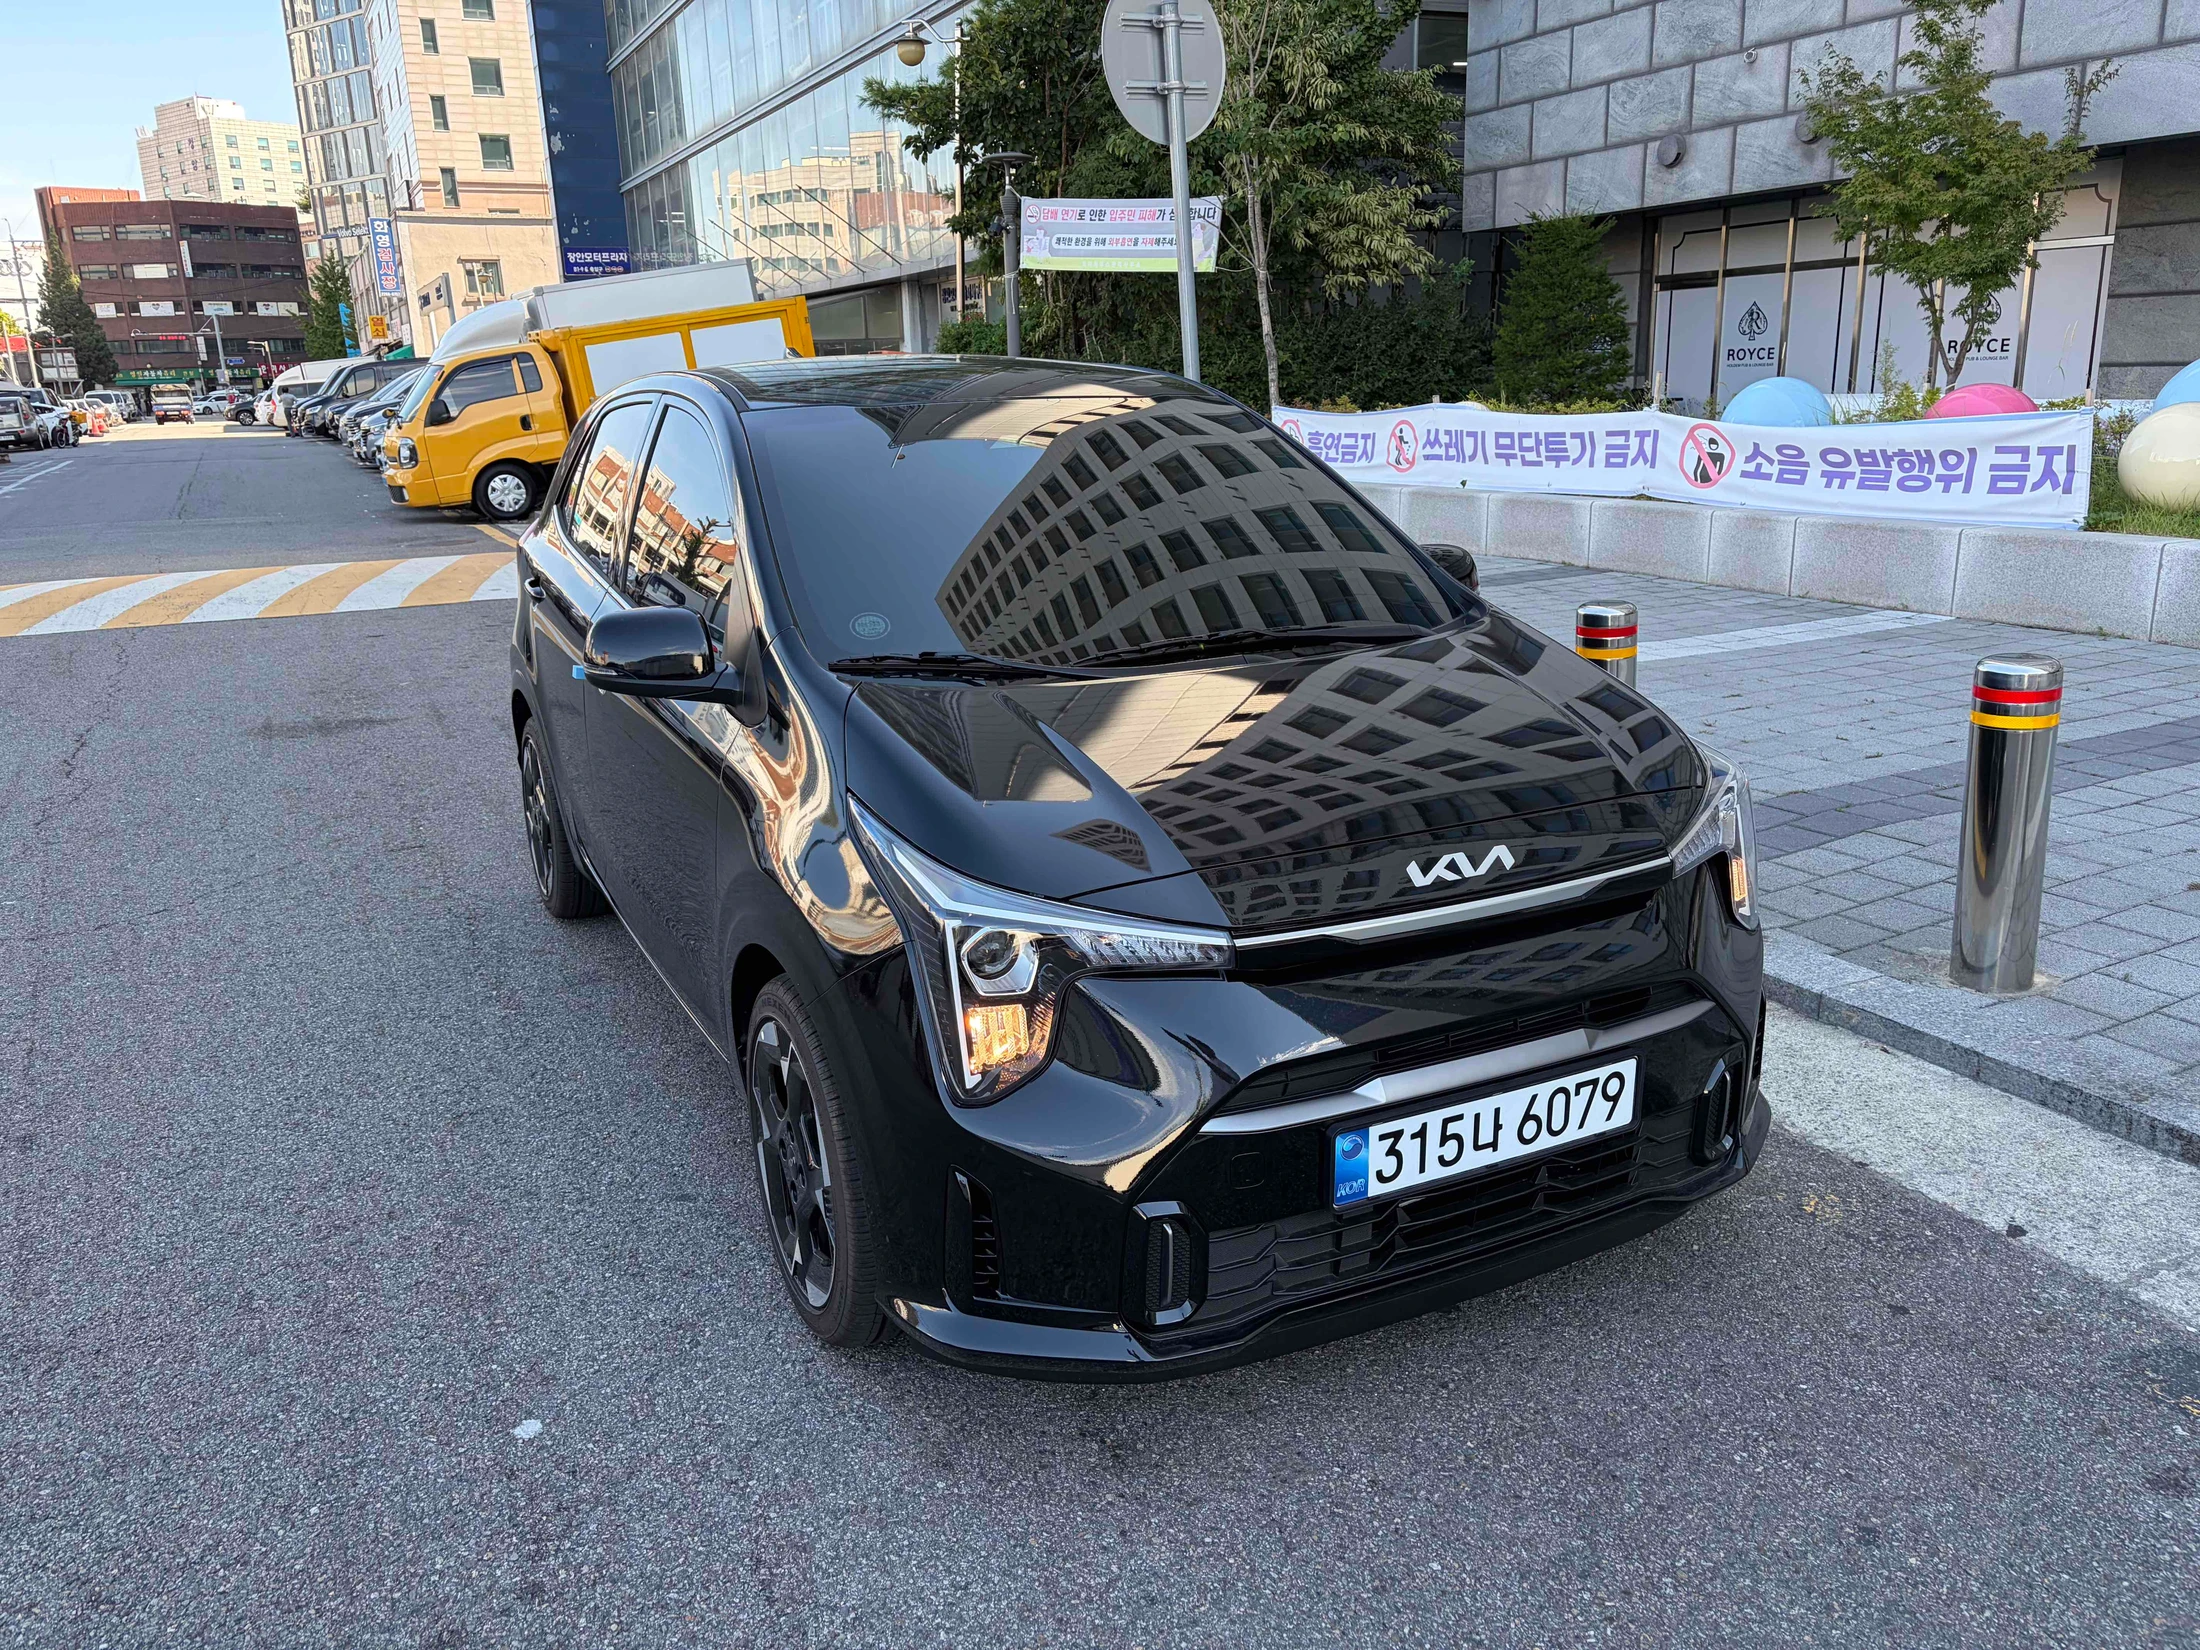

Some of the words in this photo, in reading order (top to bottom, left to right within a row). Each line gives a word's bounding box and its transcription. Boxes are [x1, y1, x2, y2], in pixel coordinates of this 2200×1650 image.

[1042, 208, 1059, 221] 담배
[1061, 208, 1086, 221] 연기로
[1089, 209, 1107, 222] 인한
[1109, 209, 1136, 222] 입주민
[1138, 208, 1166, 221] 피해가
[1055, 236, 1073, 246] 쾌적한
[1075, 236, 1093, 247] 환경을
[1094, 237, 1107, 247] 위해
[1108, 237, 1140, 247] 외부흡연을
[566, 252, 628, 263] 장안모터프라자
[370, 316, 386, 337] 열쇠
[1727, 347, 1775, 361] ROYCE
[1306, 431, 1376, 464] 흡연금지
[1422, 428, 1489, 465] 쓰레기
[1494, 430, 1596, 468] 무단투기
[1604, 429, 1660, 469] 금지
[1739, 441, 1811, 485] 소음
[1818, 446, 1977, 494] 유발행위
[1986, 444, 2077, 495] 금지
[1406, 844, 1516, 888] KIA
[1375, 1106, 1503, 1184] 315나
[1517, 1071, 1626, 1146] 6079
[1336, 1178, 1366, 1198] KOR
